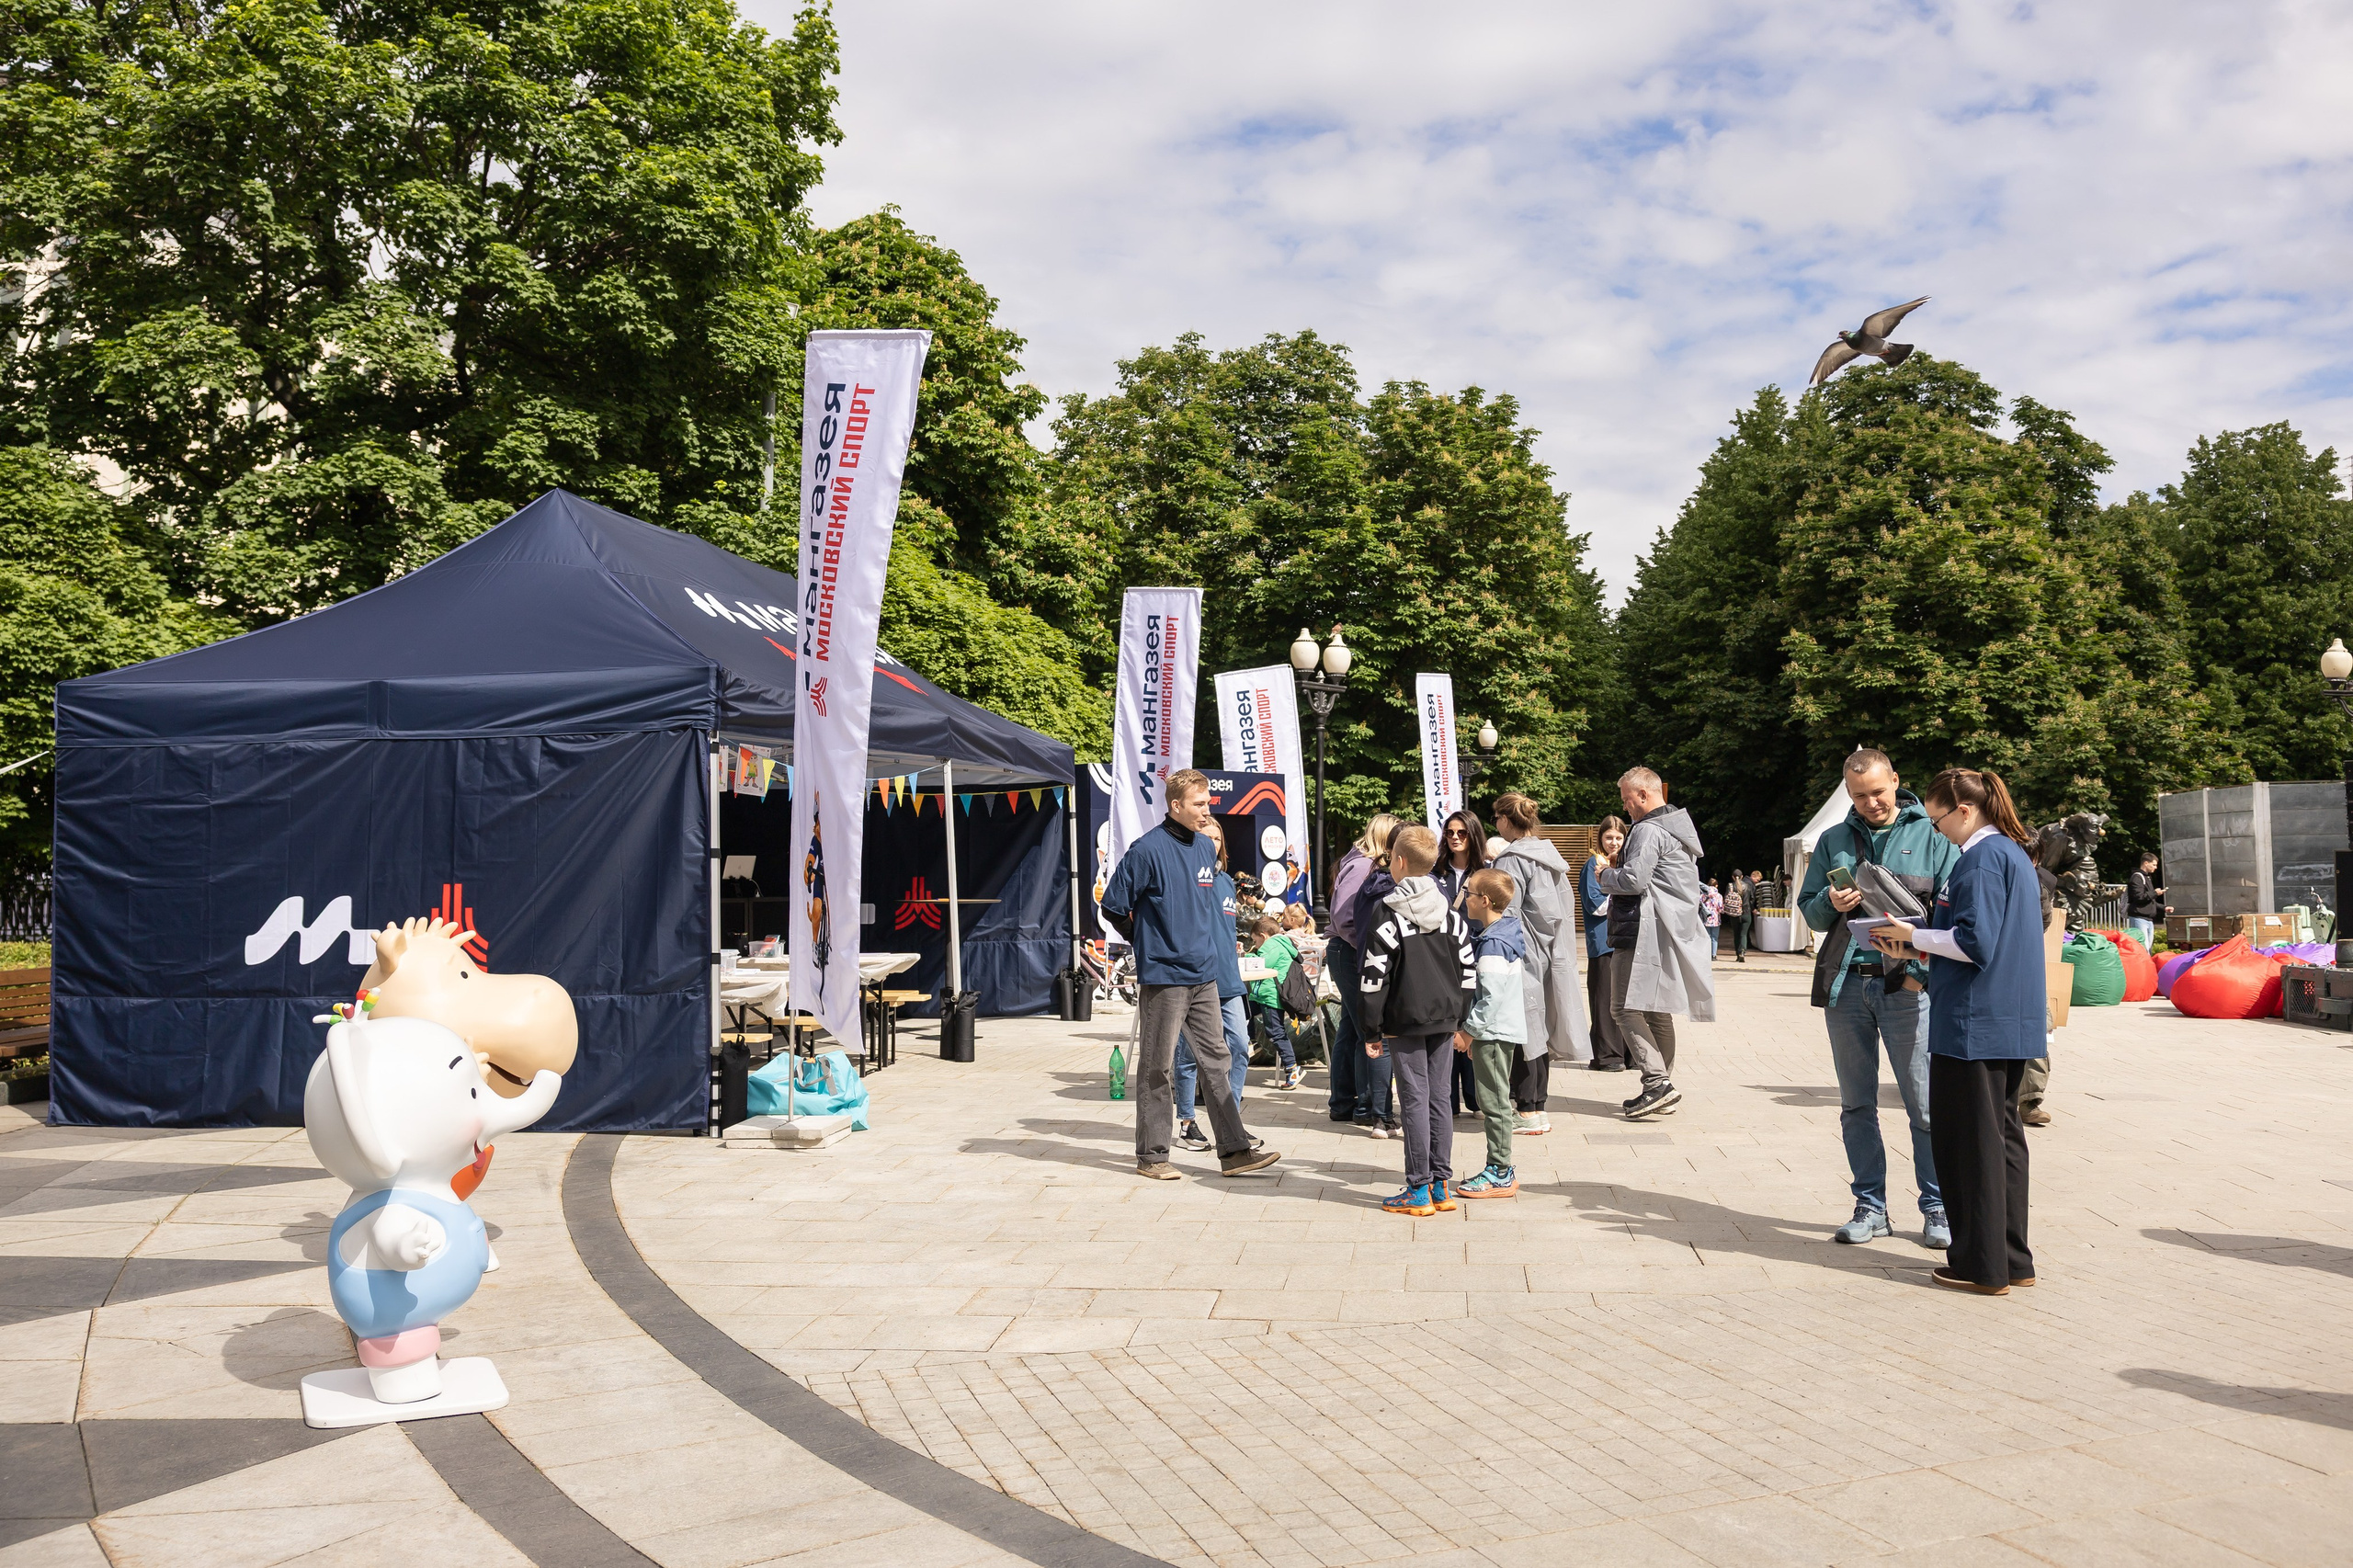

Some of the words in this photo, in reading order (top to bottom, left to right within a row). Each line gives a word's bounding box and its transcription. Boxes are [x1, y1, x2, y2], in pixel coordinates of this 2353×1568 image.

[803, 383, 847, 657] мангазея
[816, 476, 854, 662] МОСКОВСКИЙ
[839, 383, 875, 468] СПОРТ
[1164, 615, 1179, 659] СПОРТ
[1141, 615, 1161, 756] мангазея
[1160, 663, 1174, 756] МОСКОВСКИЙ
[1256, 688, 1272, 721] СПОРТ
[1437, 693, 1446, 725] СПОРТ
[1427, 694, 1442, 796] мангазея
[1438, 728, 1449, 796] МОСКОВСКИЙ
[1360, 910, 1477, 993] EXPEITION
